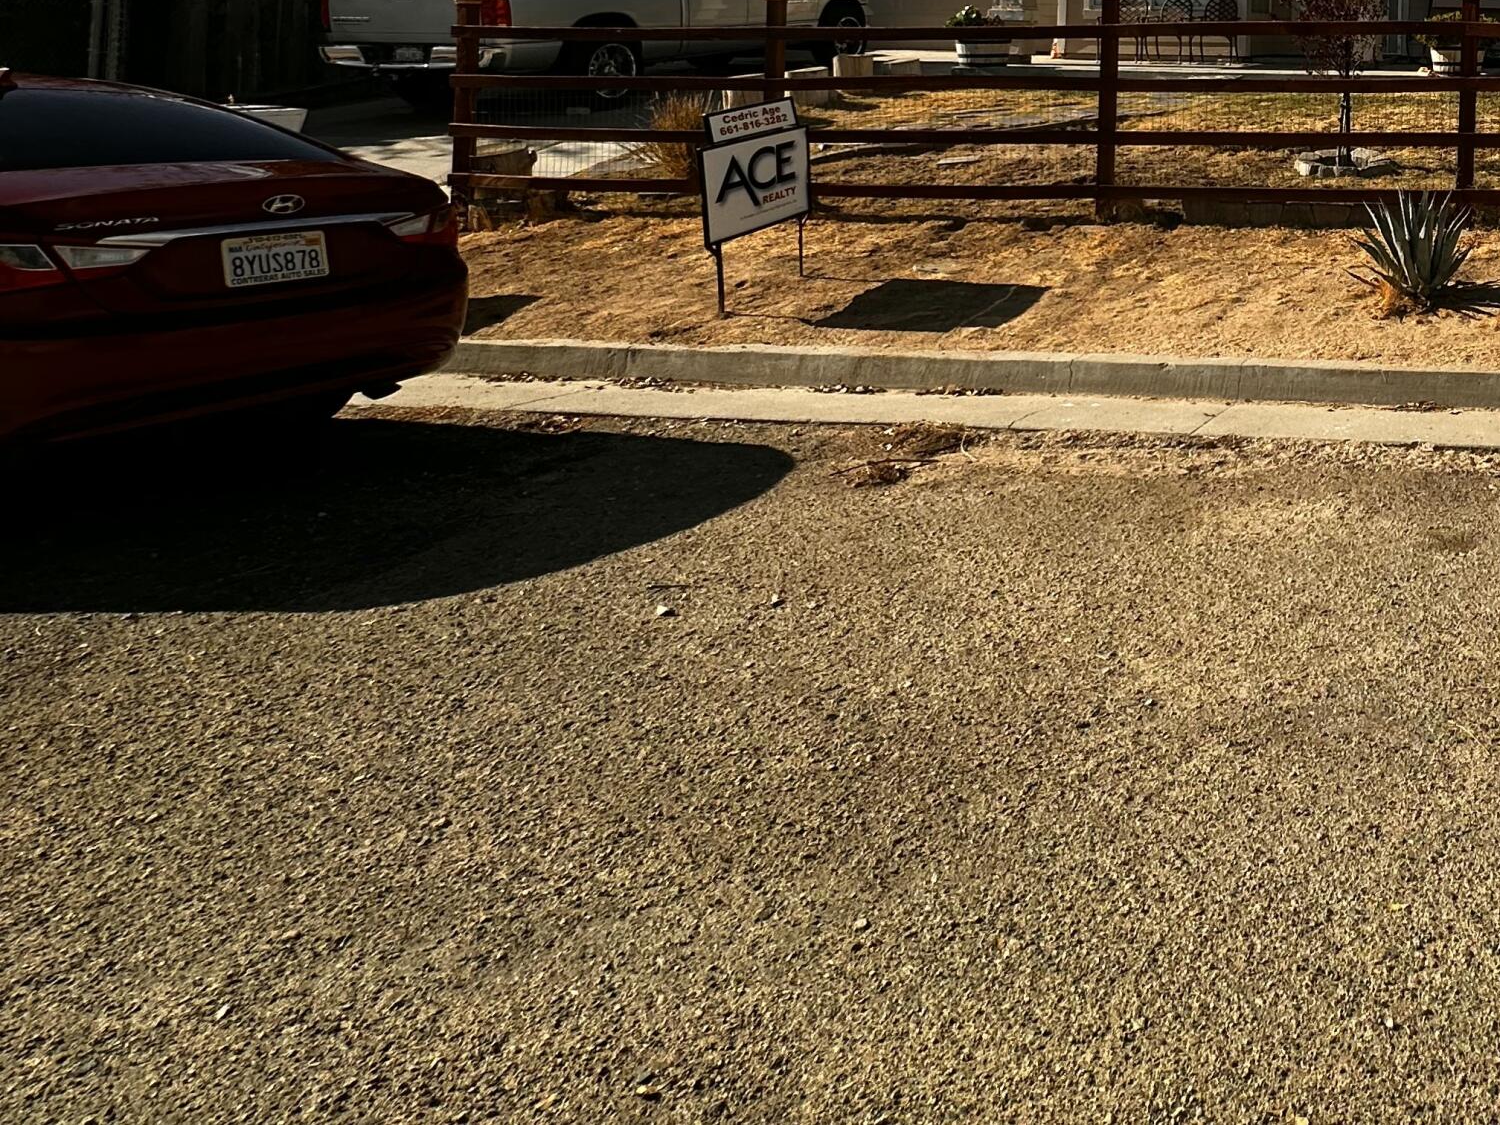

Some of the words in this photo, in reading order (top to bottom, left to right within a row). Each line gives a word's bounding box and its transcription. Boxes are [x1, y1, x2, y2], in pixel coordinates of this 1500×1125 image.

[722, 110, 759, 124] Cedric
[762, 106, 781, 117] Age
[720, 114, 788, 135] 661-816-3282
[715, 140, 796, 206] ACE
[762, 186, 797, 204] REALTY
[53, 217, 159, 231] SONATA
[232, 249, 320, 277] 8YUS878
[231, 274, 279, 285] CONTRERAS
[281, 270, 302, 279] AUTO
[303, 267, 326, 277] SALES
